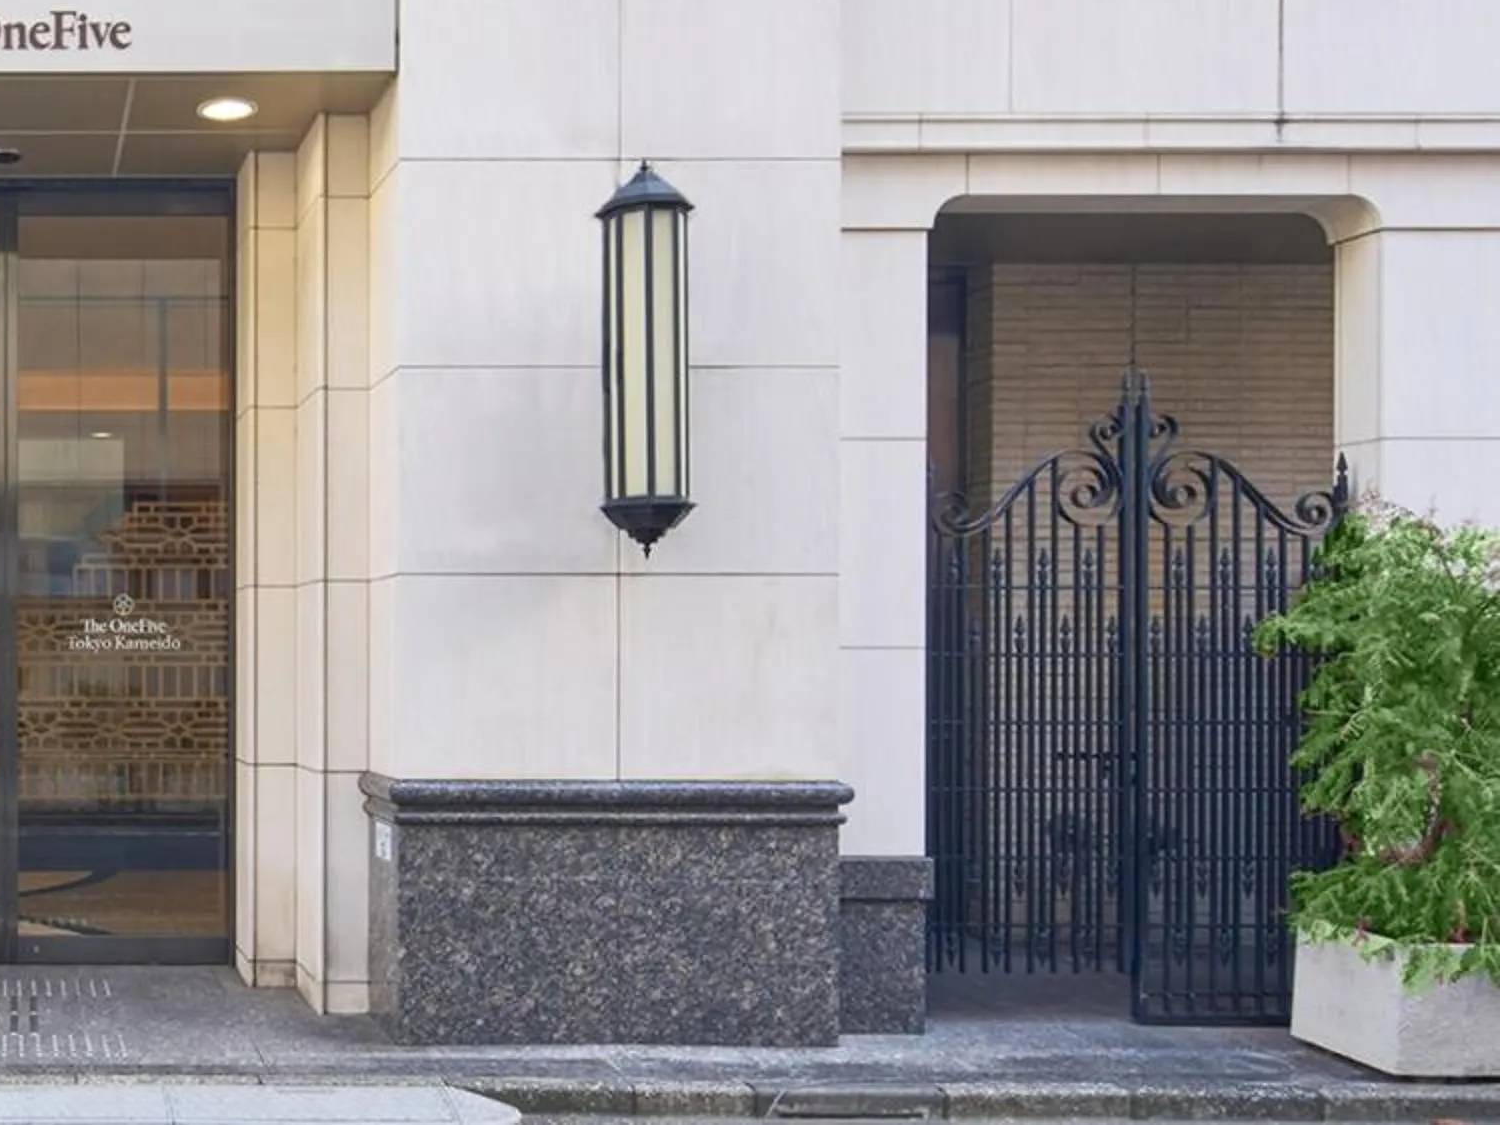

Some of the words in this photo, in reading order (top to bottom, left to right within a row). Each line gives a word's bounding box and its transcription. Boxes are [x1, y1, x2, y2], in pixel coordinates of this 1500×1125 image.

[82, 618, 108, 633] The
[67, 634, 112, 653] Tokyo
[115, 634, 181, 650] Kameido
